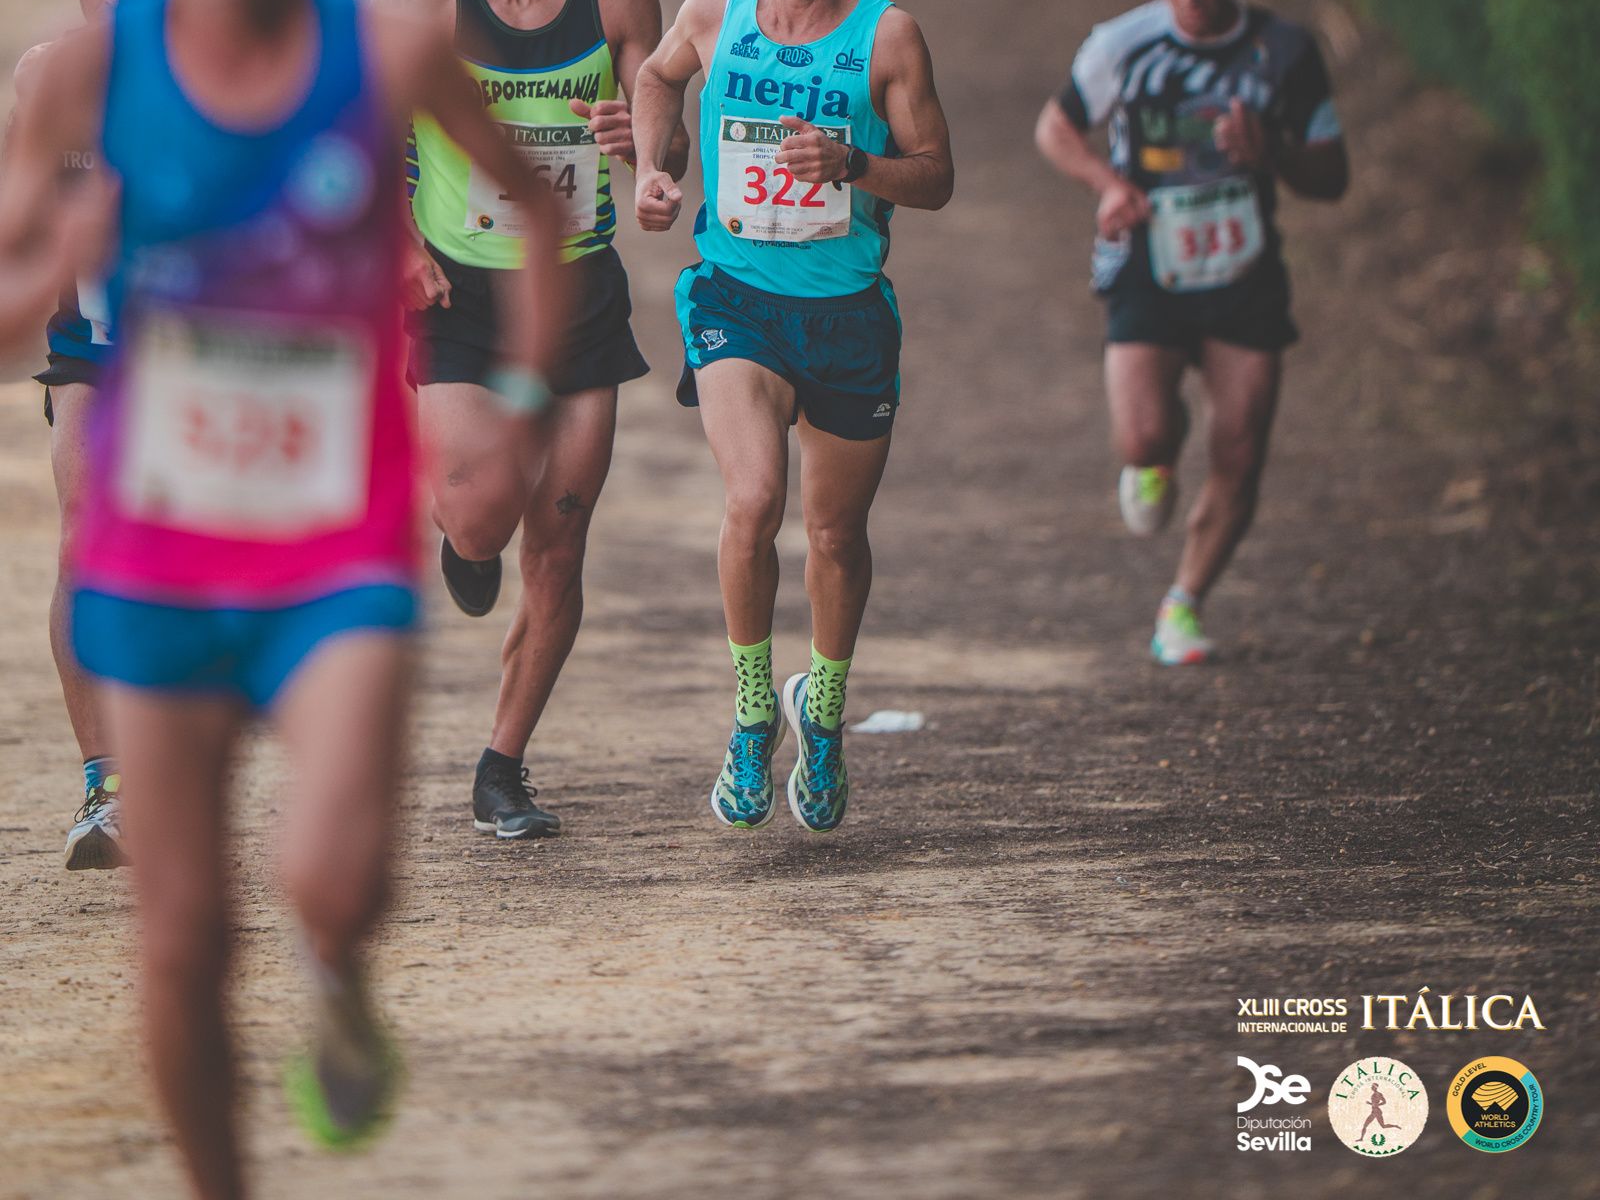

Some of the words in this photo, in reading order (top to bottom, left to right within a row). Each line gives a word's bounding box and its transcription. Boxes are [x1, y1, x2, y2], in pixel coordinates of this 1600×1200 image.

[778, 47, 812, 65] TROPS
[473, 72, 601, 106] EPORTEMANIA
[724, 70, 850, 122] nerja
[514, 128, 571, 143] ITÁLICA
[743, 166, 826, 208] 322
